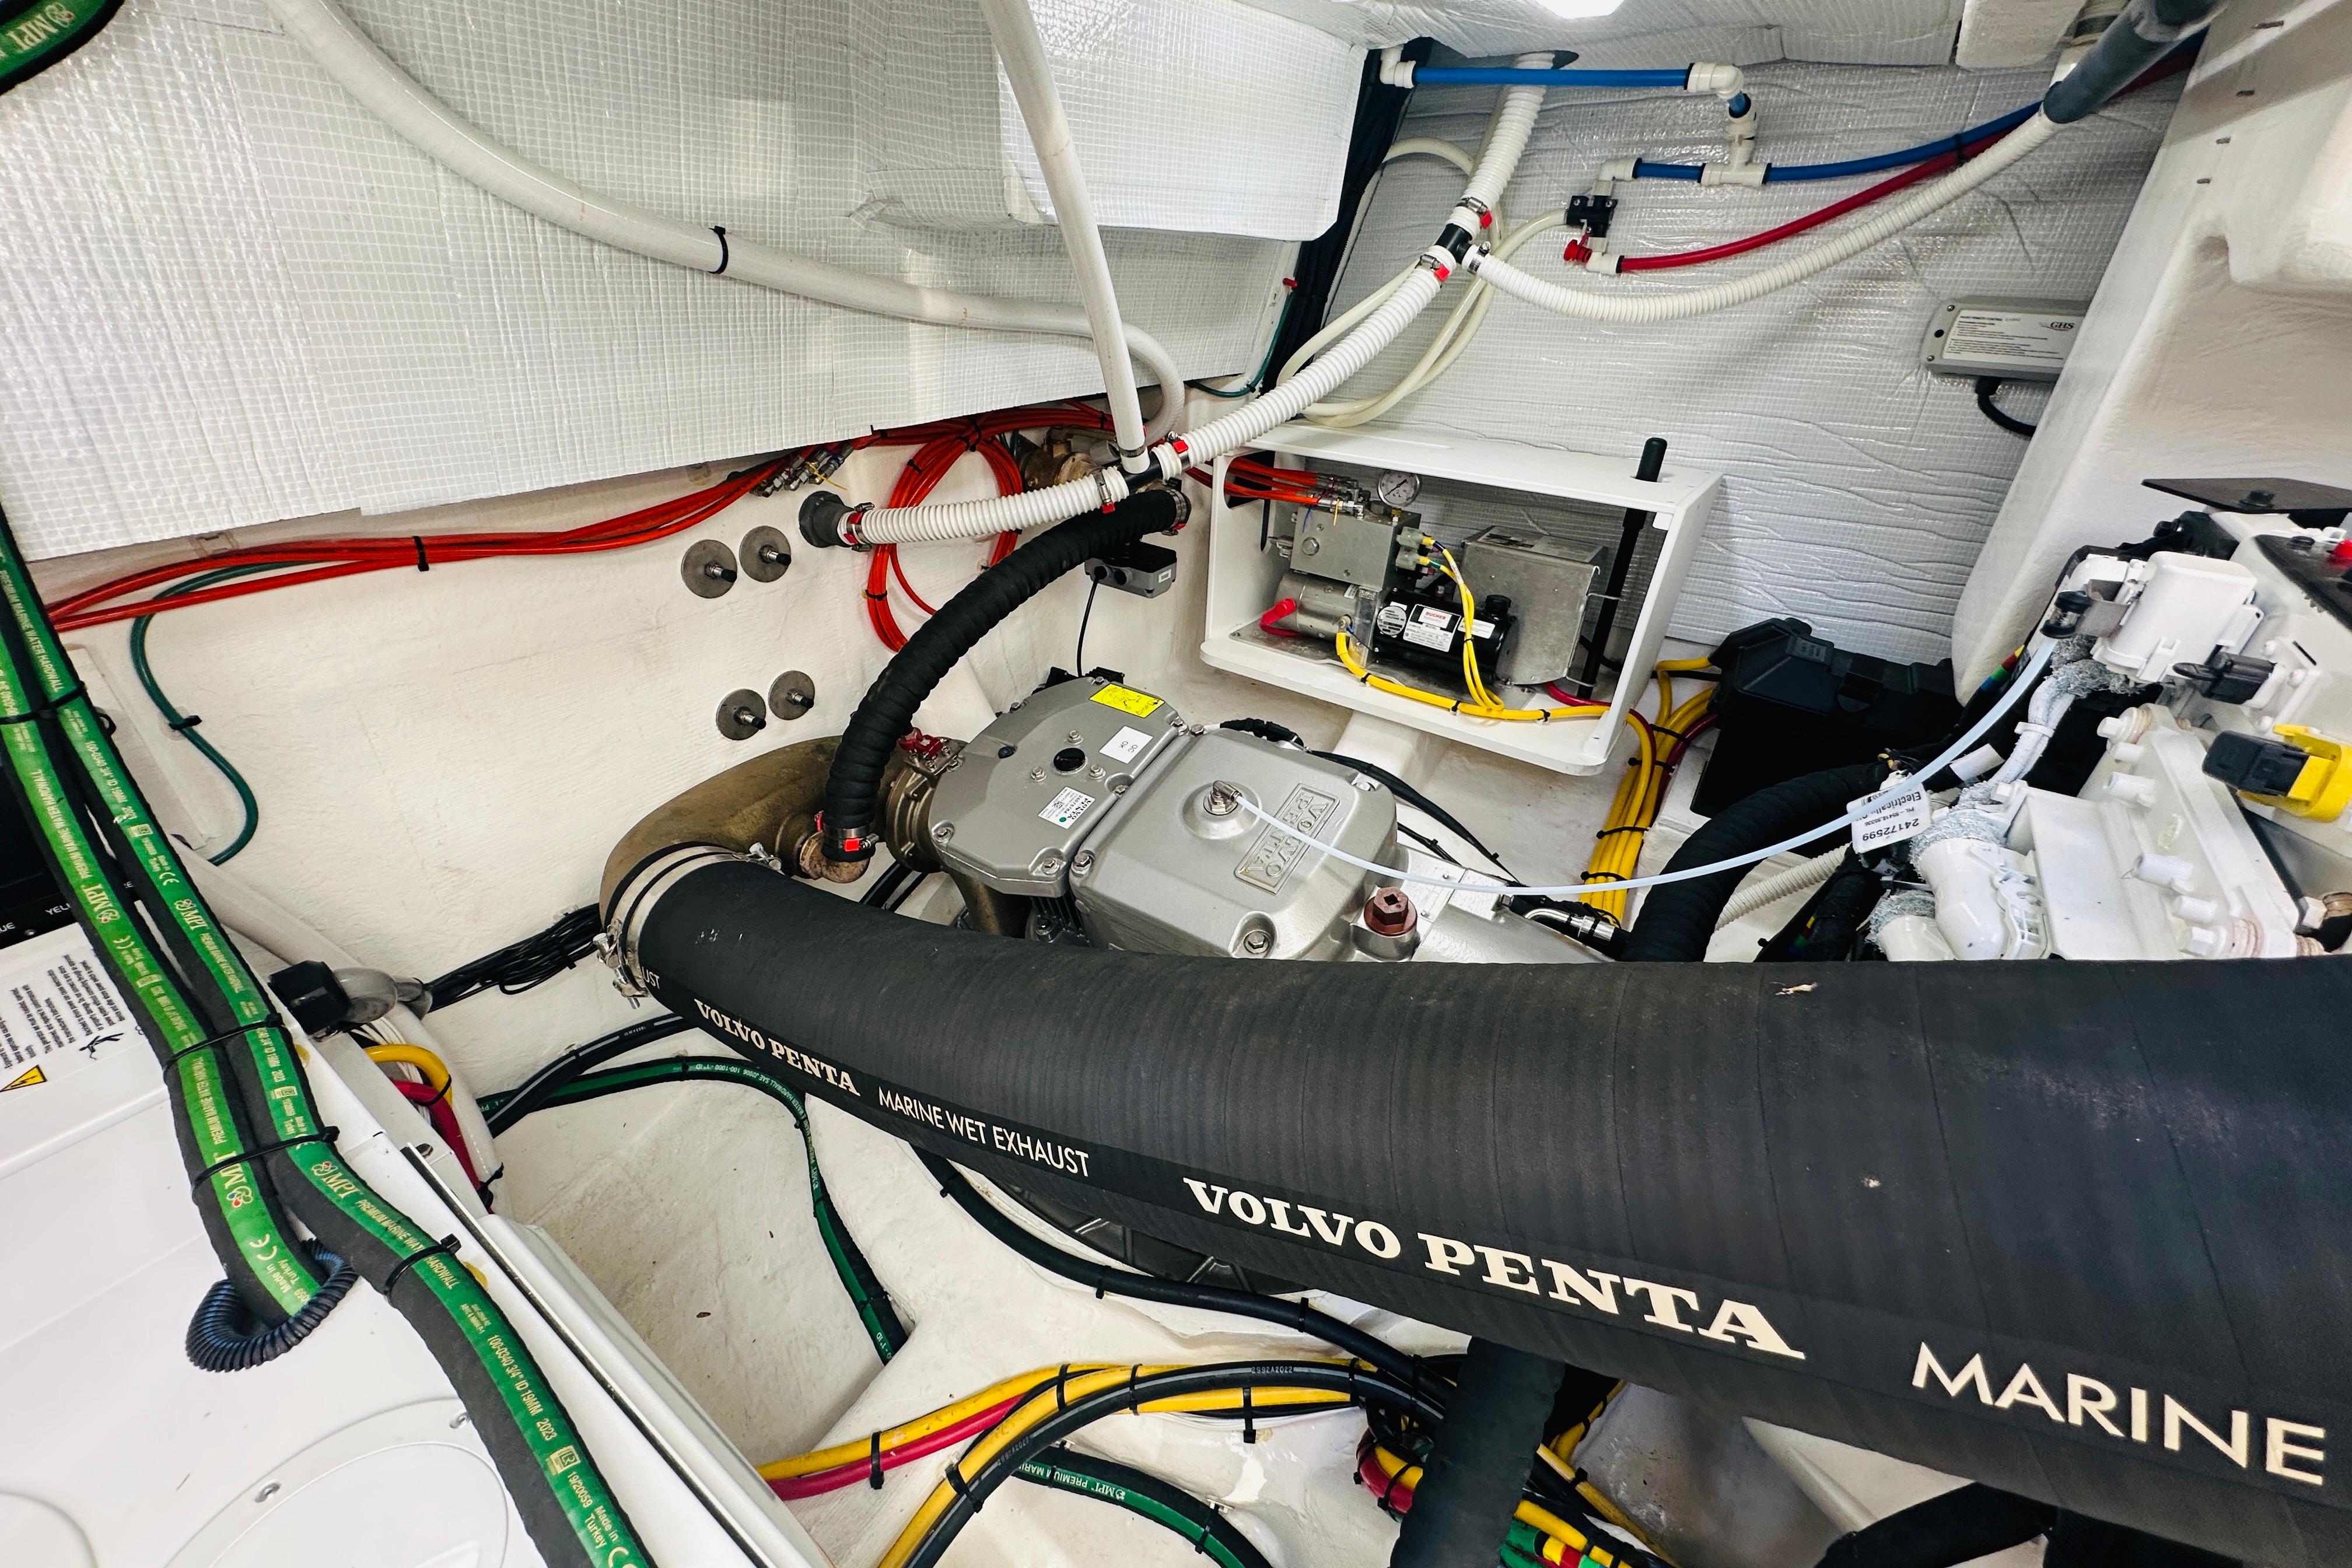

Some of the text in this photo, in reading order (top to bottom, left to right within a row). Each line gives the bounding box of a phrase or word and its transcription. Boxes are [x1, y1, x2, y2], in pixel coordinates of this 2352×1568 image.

[1871, 792, 1922, 814] Electricall
[1863, 818, 1919, 841] 24172599
[80, 884, 113, 912] MPI
[181, 907, 209, 930] MPI
[694, 999, 1089, 1177] VOLVO PENTA MARINE WET EXHAUST
[769, 1079, 794, 1101] HARDWALL
[215, 1150, 247, 1189] MI
[321, 1172, 360, 1199] MPI
[425, 1256, 459, 1289] HARDWALL
[1183, 1177, 2326, 1486] VOLVO PENTA MARINE
[488, 1335, 514, 1366] 100-0340
[515, 1380, 528, 1391] ID
[522, 1391, 543, 1416] 19MM
[536, 1418, 558, 1441] 2023
[1251, 1366, 1294, 1376] 2992A2022
[568, 1471, 593, 1508] 19/20059
[1096, 1482, 1116, 1497] MPI
[585, 1513, 607, 1549] Turkey
[594, 1506, 619, 1542] Made in
